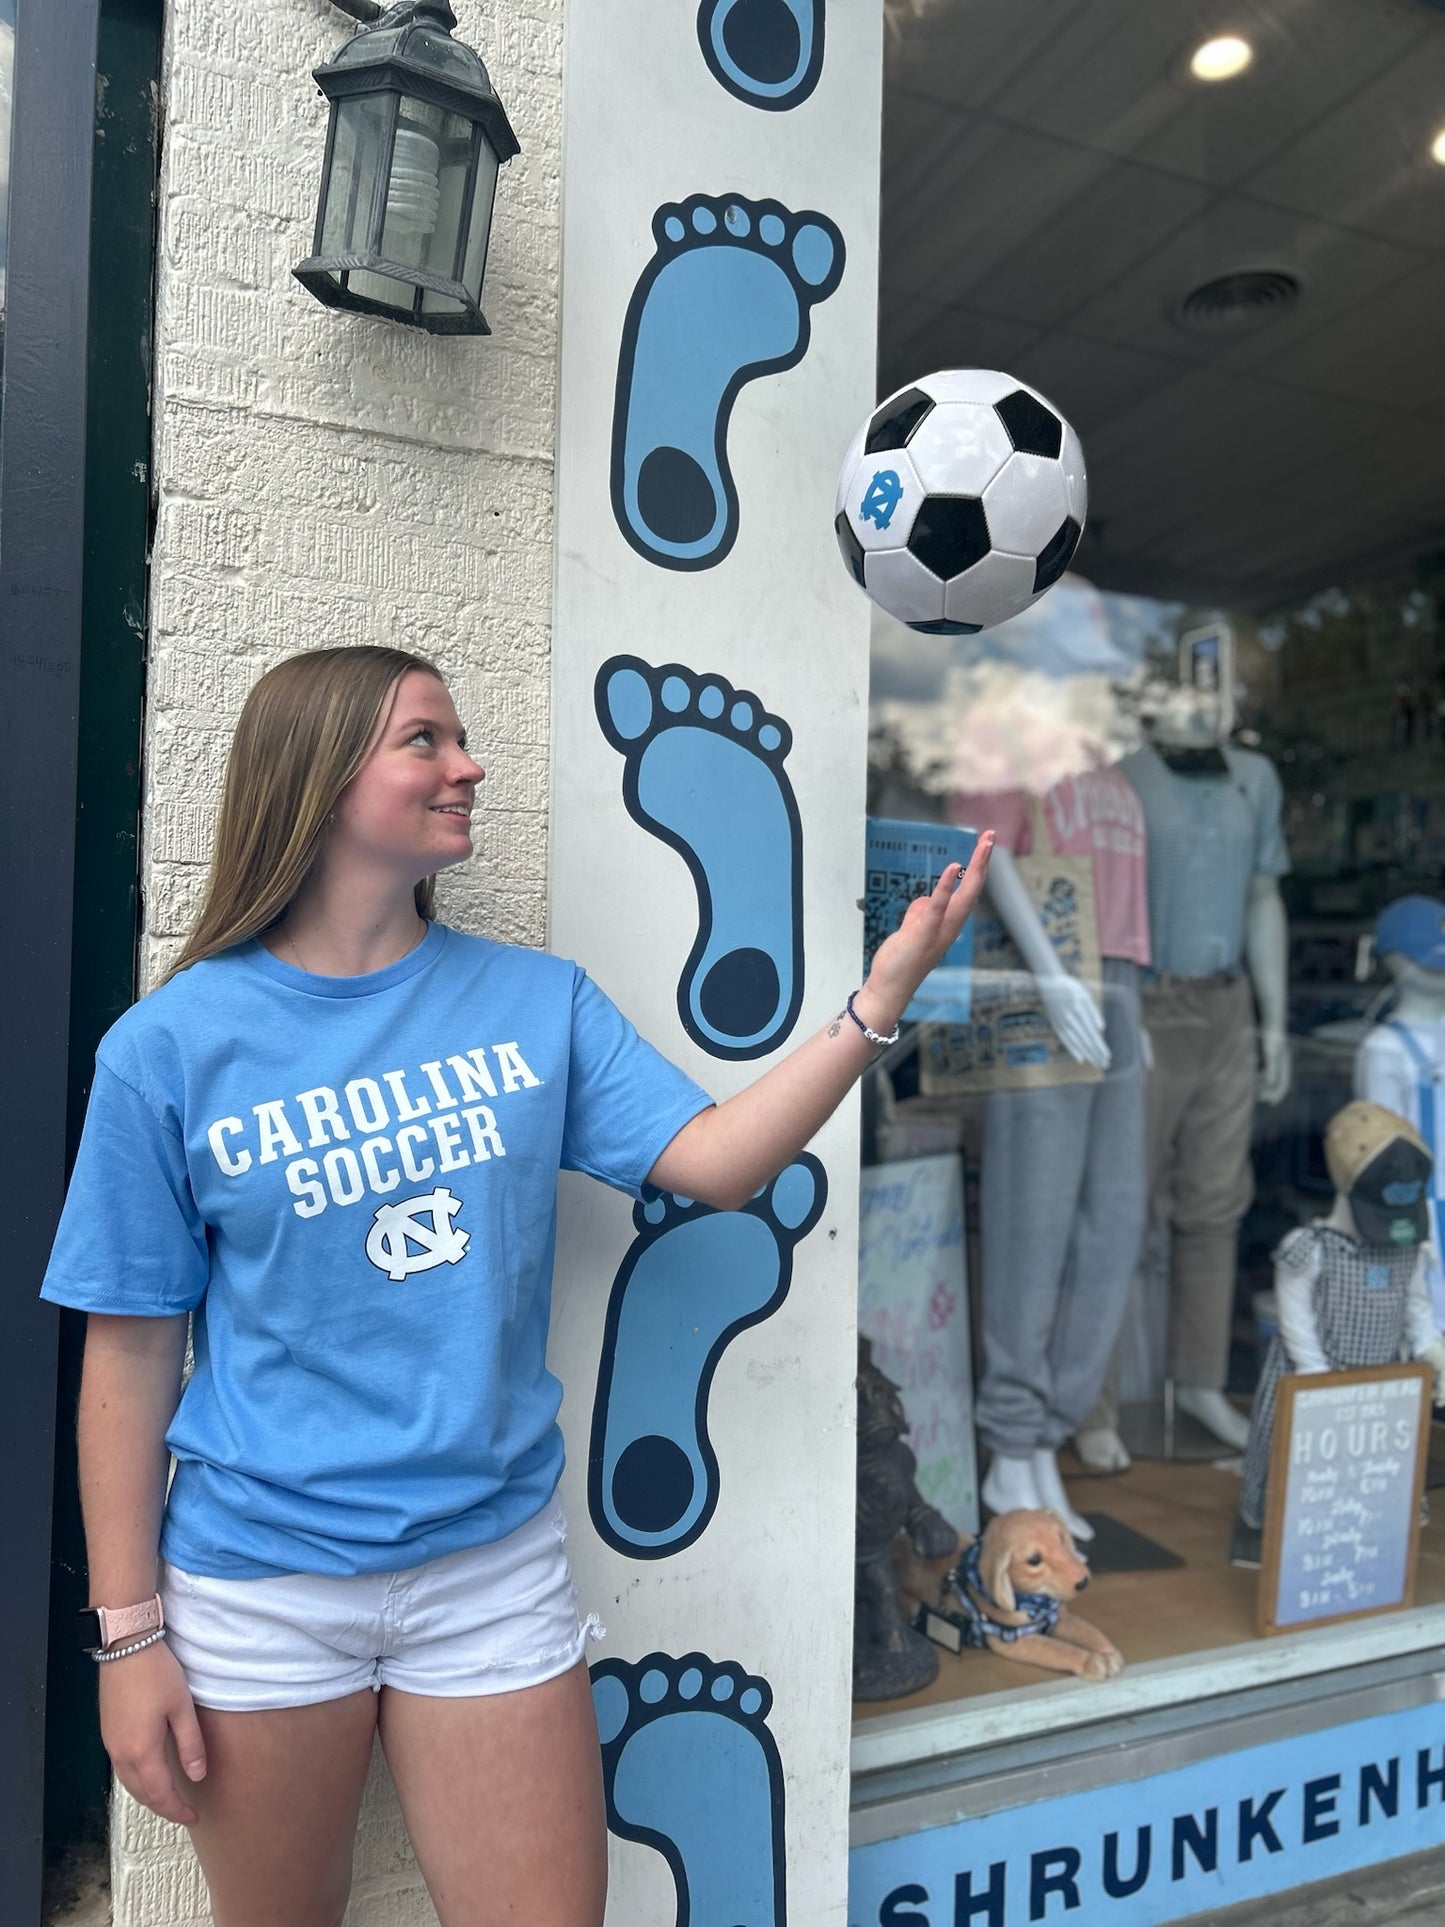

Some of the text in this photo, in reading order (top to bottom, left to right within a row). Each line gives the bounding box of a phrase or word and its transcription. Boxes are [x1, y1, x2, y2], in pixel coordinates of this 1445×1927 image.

[207, 1041, 541, 1177] CAROLINA
[285, 1105, 507, 1219] SOCCER
[1294, 1418, 1412, 1465] HOURS
